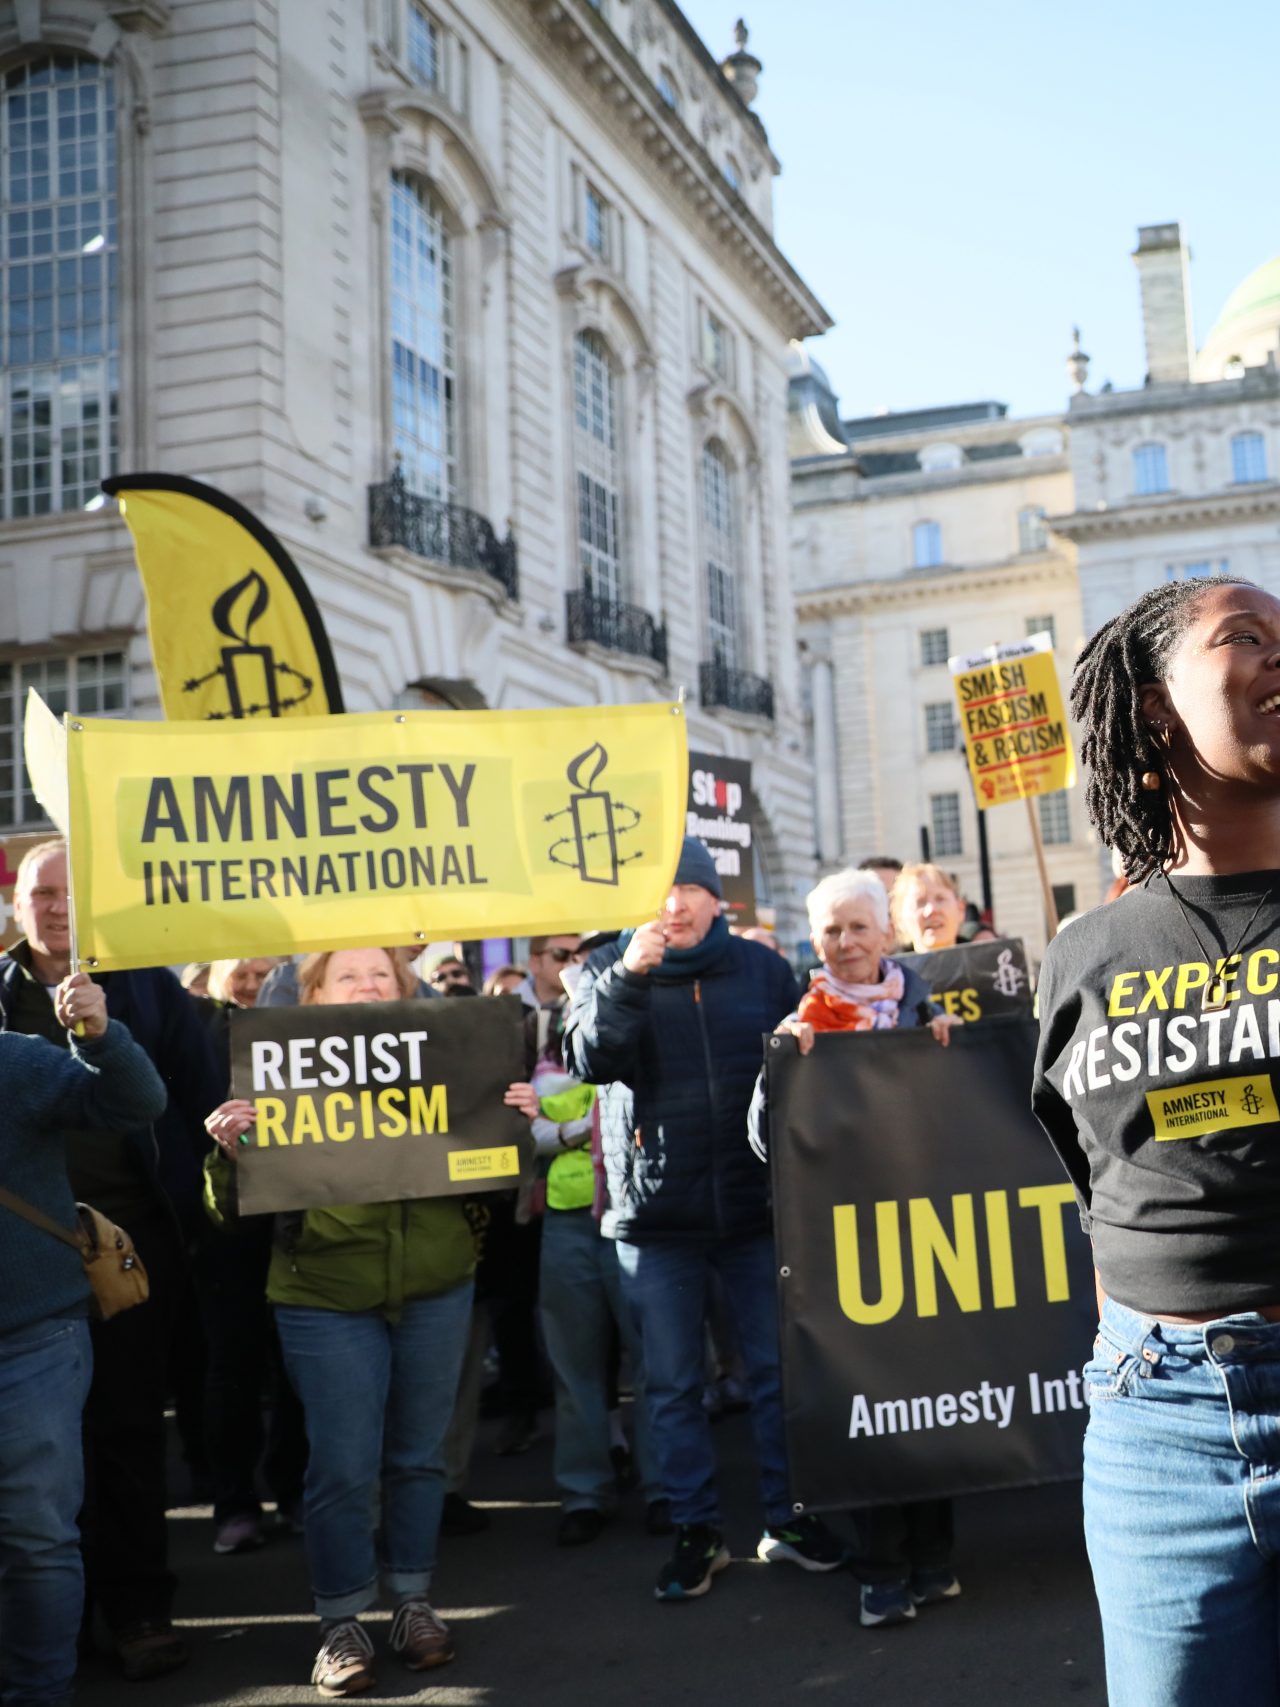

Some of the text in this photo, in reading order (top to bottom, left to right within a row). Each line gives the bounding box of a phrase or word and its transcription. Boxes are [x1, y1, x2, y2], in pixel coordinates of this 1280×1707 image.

[959, 663, 1027, 701] SMASH
[966, 692, 1049, 734] FASCISM
[973, 722, 1066, 766] & RACISM
[141, 764, 477, 843] AMNESTY
[691, 769, 743, 816] Stop
[143, 845, 488, 906] INTERNATIONAL
[702, 839, 742, 876] ran
[251, 1031, 429, 1092] RESIST
[255, 1084, 449, 1148] RACISM
[1162, 1089, 1226, 1116] AMNESTY
[1166, 1107, 1230, 1129] INTERNATIONAL
[833, 1183, 1077, 1325] UNIT
[848, 1380, 1015, 1439] Amnesty
